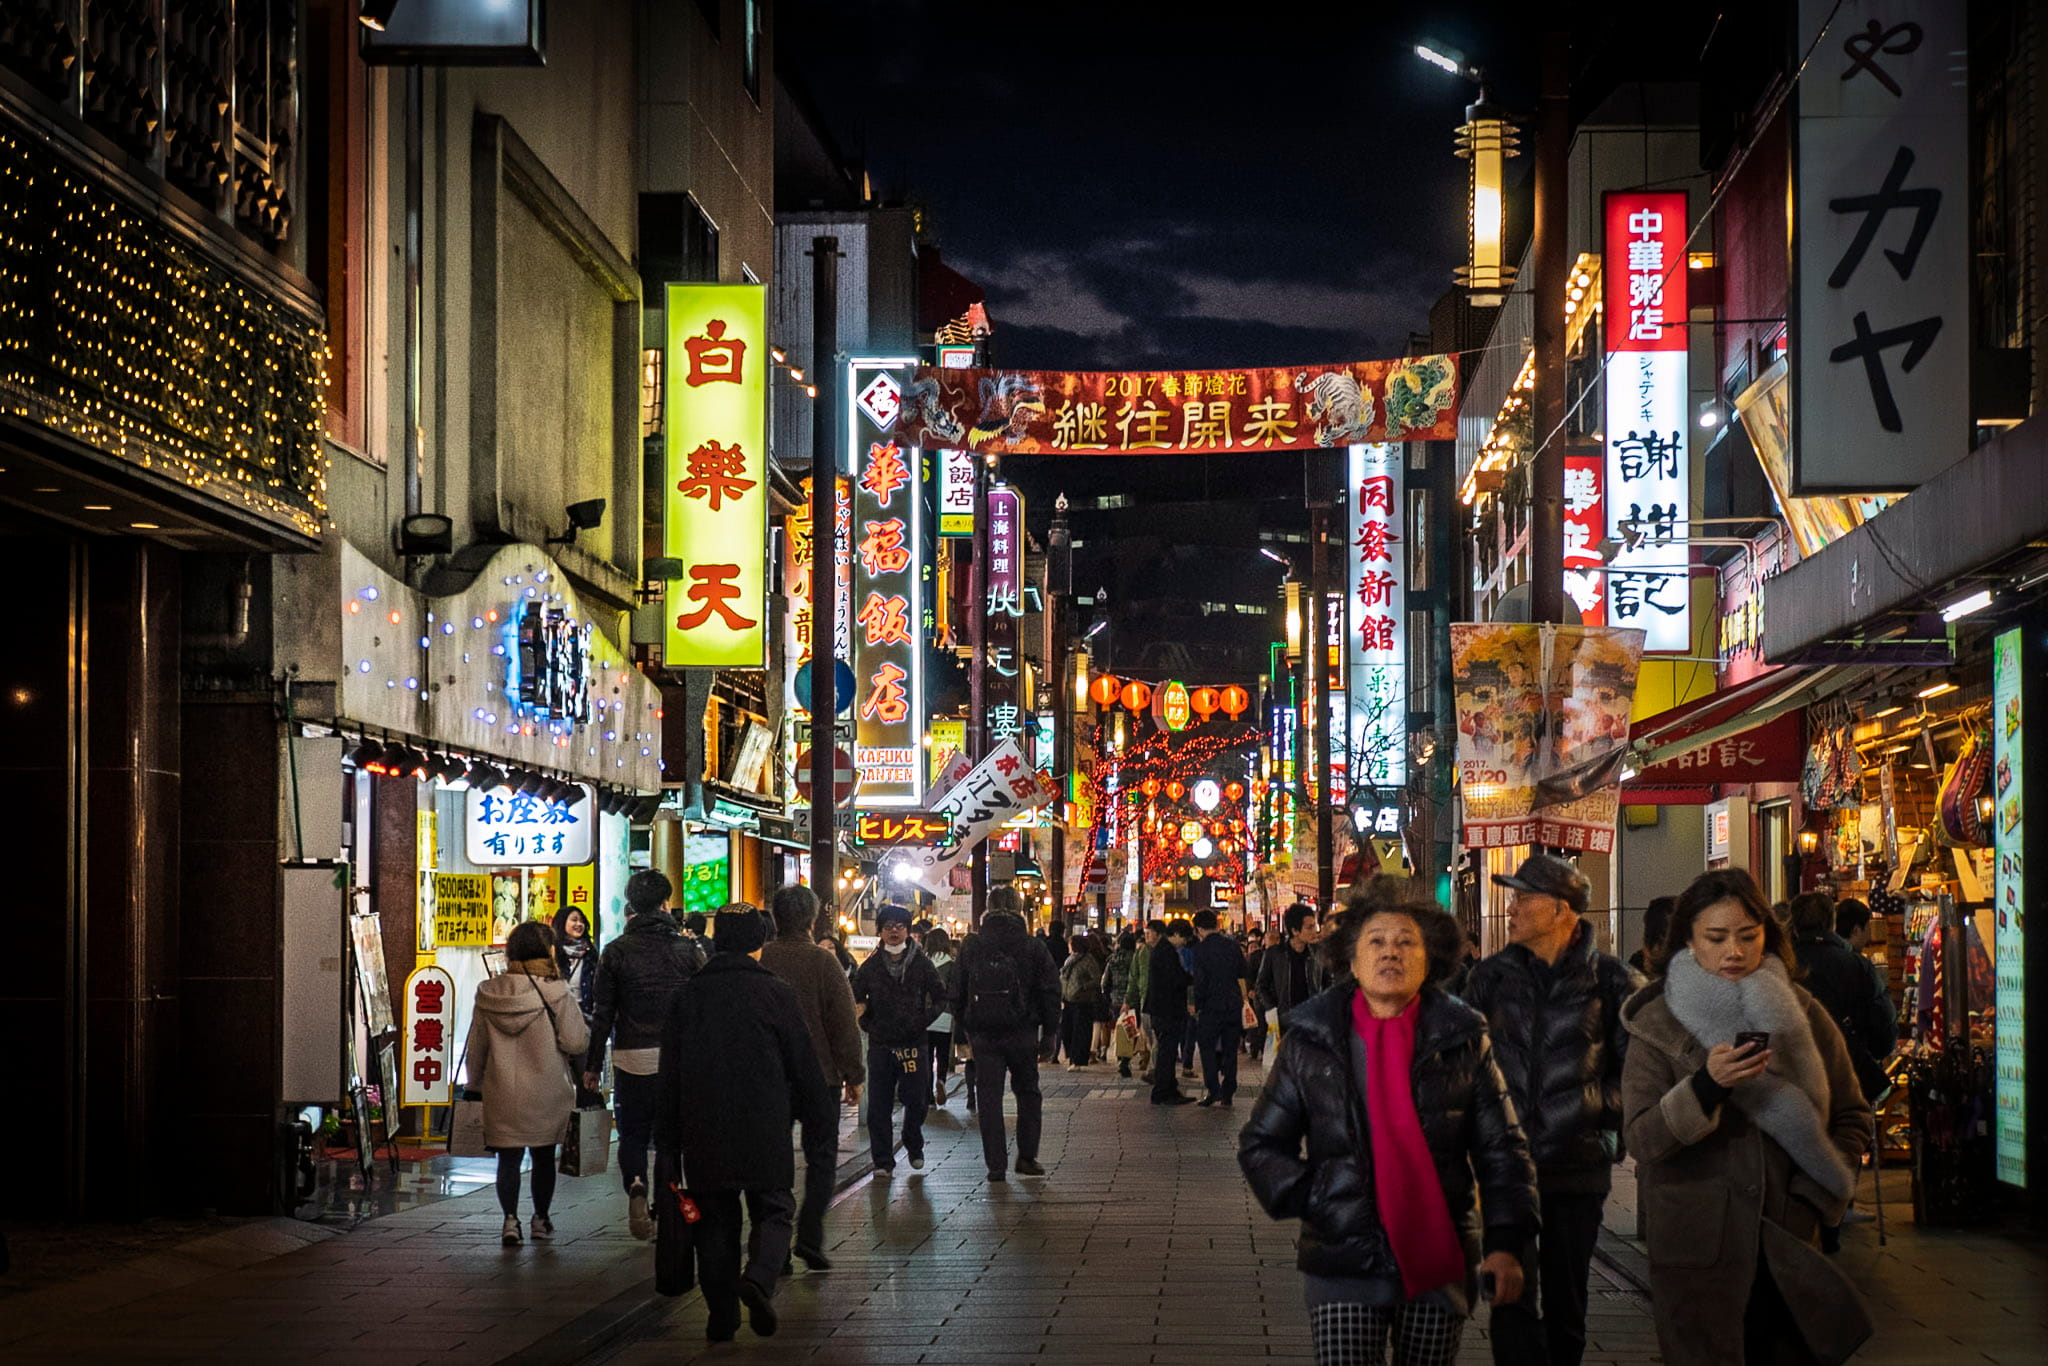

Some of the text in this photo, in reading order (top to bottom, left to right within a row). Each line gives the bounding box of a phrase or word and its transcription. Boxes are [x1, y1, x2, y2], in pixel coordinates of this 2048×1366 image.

[1628, 208, 1663, 341] 中華粥店
[1828, 145, 1943, 434] カヤ
[1638, 356, 1655, 423] シャテンキ
[1051, 396, 1299, 451] 継往開来
[993, 501, 1009, 574] 上海料理
[858, 443, 913, 722] 華福飯店
[857, 749, 914, 764] KAFUKU
[861, 767, 913, 782] ANTEN
[994, 752, 1038, 799] 本店
[1464, 769, 1508, 784] 3/20
[483, 831, 566, 856] 有ります
[414, 980, 445, 1091] 営業中
